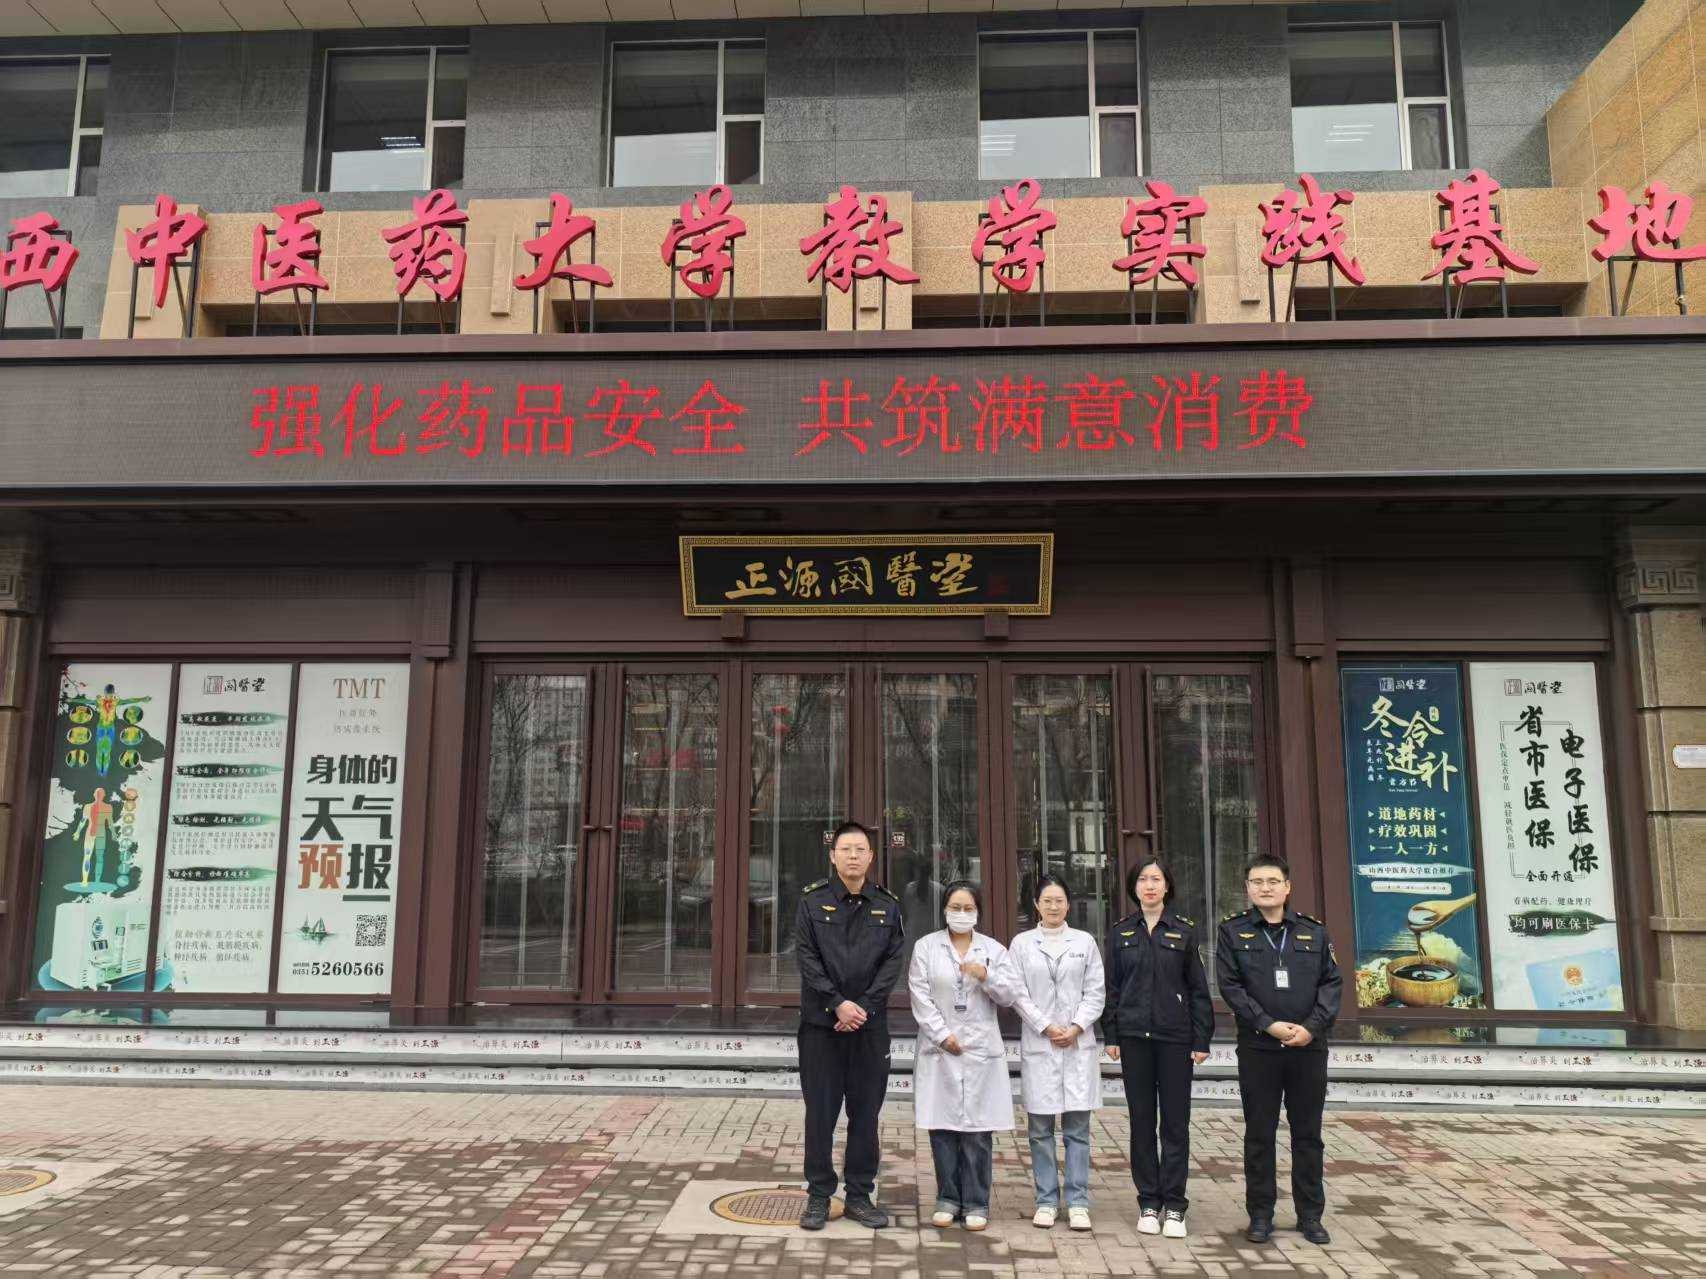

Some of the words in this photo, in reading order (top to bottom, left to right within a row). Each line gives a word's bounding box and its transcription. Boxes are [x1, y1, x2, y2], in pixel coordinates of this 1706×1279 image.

[0, 168, 1706, 307] 西中医药大学教学实践基地
[248, 378, 748, 460] 强化药品安全
[793, 368, 1315, 456] 共筑满意消费
[332, 678, 386, 699] TMT
[306, 754, 398, 785] 身体的
[1514, 705, 1556, 850] 省市医保
[1378, 806, 1437, 821] 道地药材
[1559, 728, 1600, 874] 电子医保
[300, 794, 394, 841] 天气
[1378, 824, 1437, 838] 疗效巩固
[1376, 841, 1438, 856] 一人一方
[297, 843, 393, 891] 预报
[1526, 869, 1575, 883] 全面开通
[1514, 916, 1594, 931] 均可刷医保卡
[311, 961, 384, 976] 5260566
